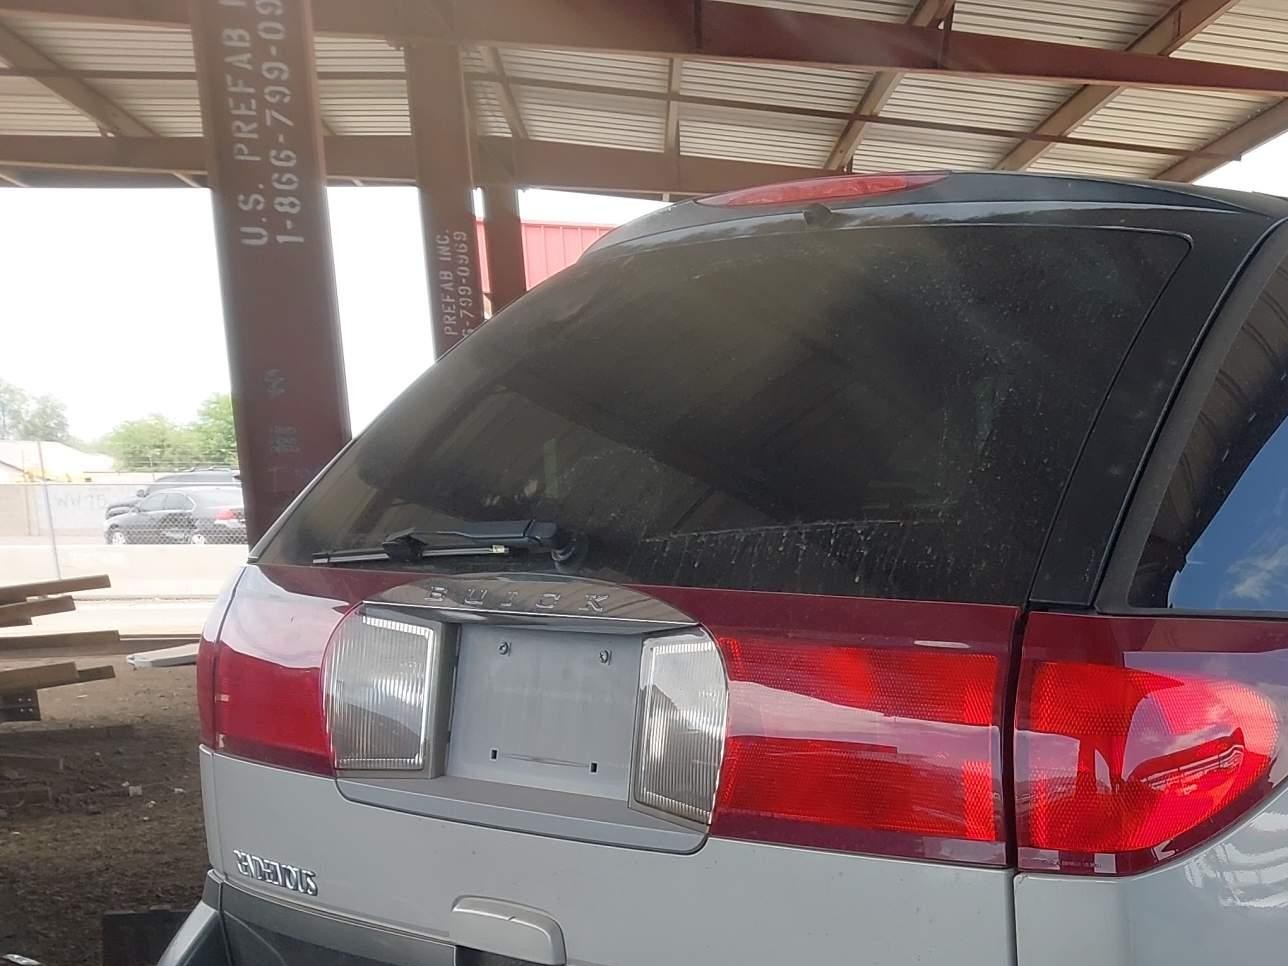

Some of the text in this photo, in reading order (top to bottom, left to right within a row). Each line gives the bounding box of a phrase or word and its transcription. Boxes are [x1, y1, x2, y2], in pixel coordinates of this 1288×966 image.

[222, 27, 261, 161] PREFAB
[237, 183, 269, 246] U.S.
[435, 229, 458, 336] PREFAB INC.
[423, 585, 609, 613] BUICK
